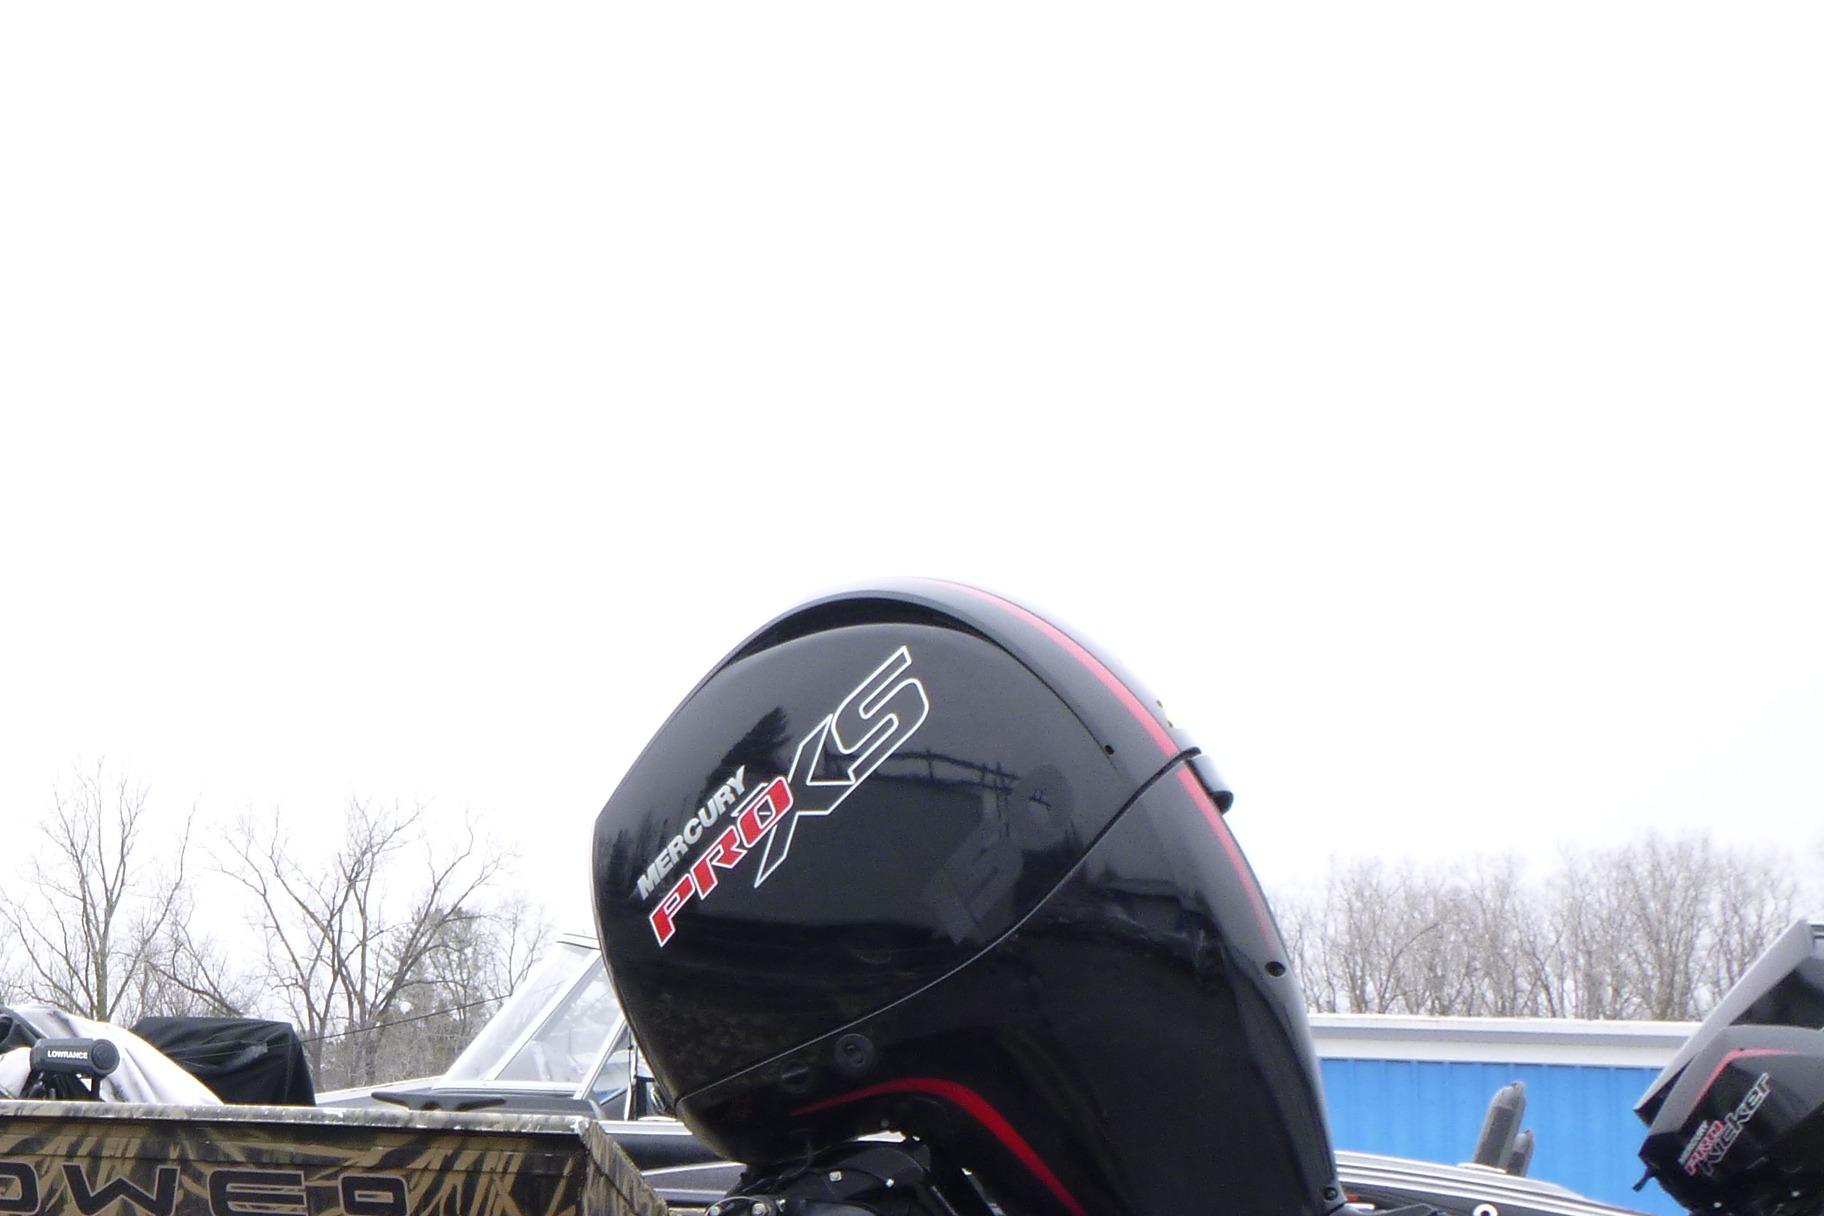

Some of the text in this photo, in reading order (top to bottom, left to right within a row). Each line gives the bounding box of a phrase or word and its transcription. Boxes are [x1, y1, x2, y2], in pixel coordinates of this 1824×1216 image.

[636, 764, 746, 900] MERCURY
[648, 645, 930, 948] PRO XS
[47, 1049, 88, 1060] LOWRANCE
